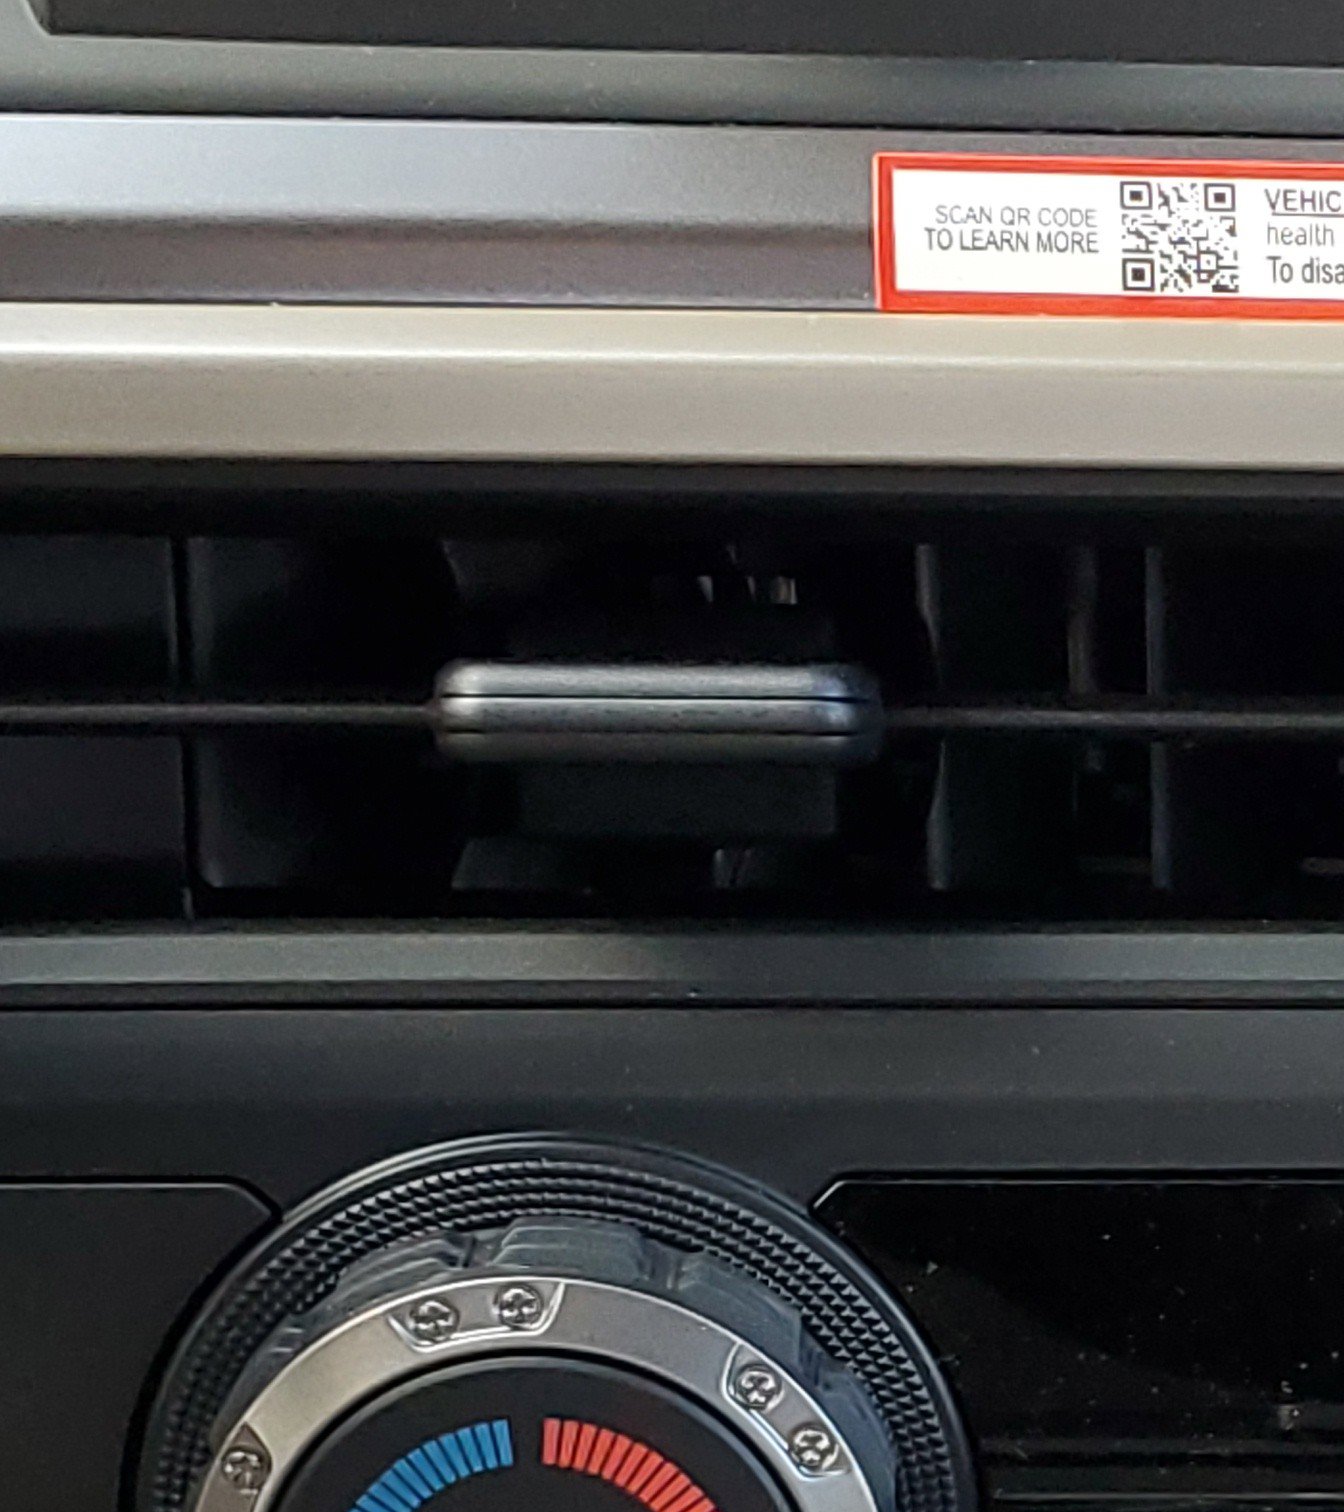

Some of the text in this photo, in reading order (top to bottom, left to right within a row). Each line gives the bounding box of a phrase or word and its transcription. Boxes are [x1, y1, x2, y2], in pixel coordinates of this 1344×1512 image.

[935, 204, 1097, 228] SCAN QR CODE
[924, 228, 1099, 254] TO LEARN MORE
[1266, 222, 1334, 246] health
[1267, 256, 1294, 283] To
